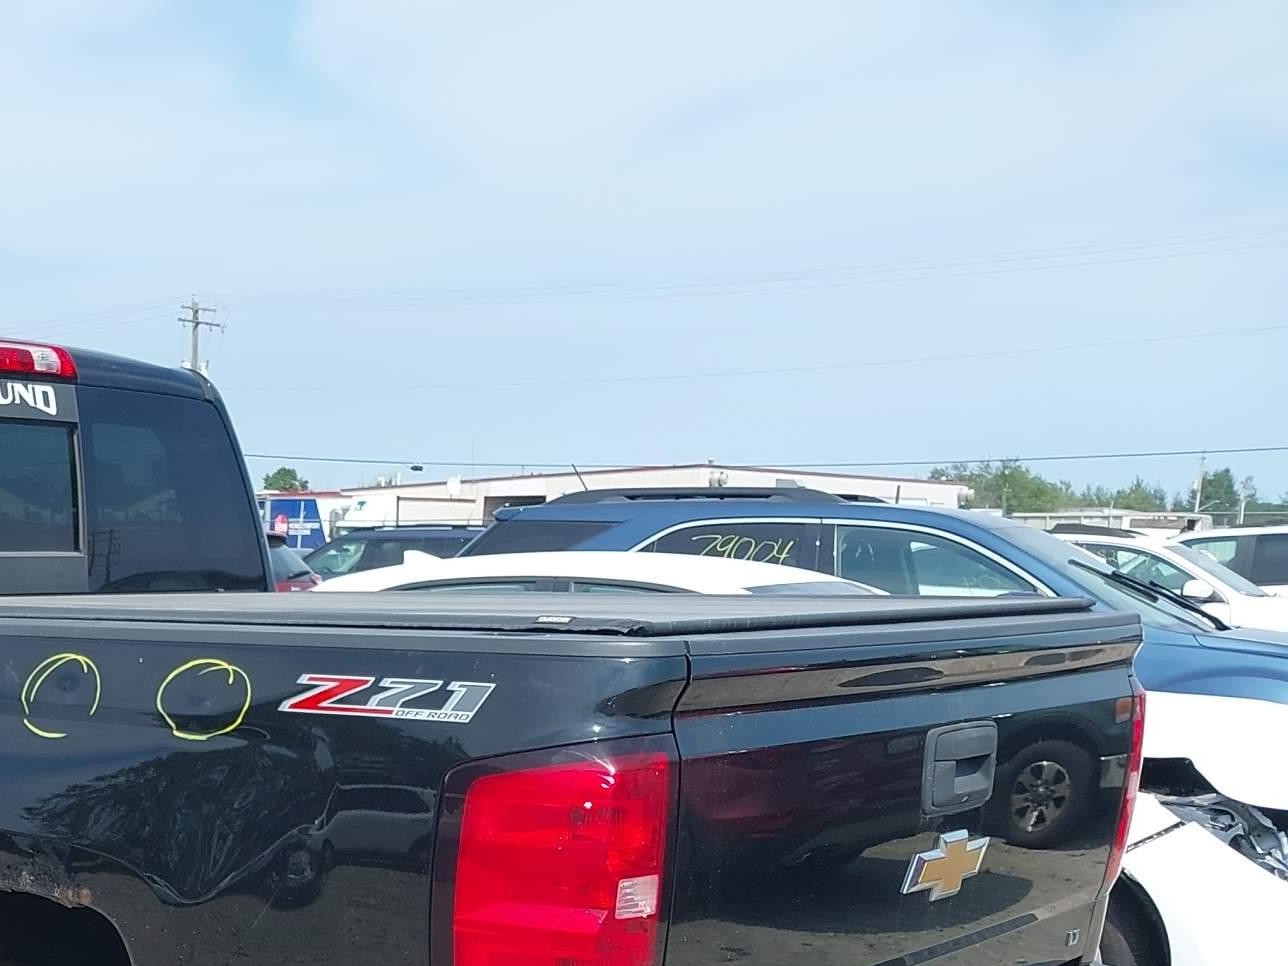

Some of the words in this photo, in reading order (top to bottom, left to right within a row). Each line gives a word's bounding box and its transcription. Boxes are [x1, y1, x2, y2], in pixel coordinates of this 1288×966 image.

[691, 533, 795, 566] 79004
[277, 673, 497, 717] Z71
[395, 708, 424, 718] OFF
[429, 710, 471, 722] ROAD
